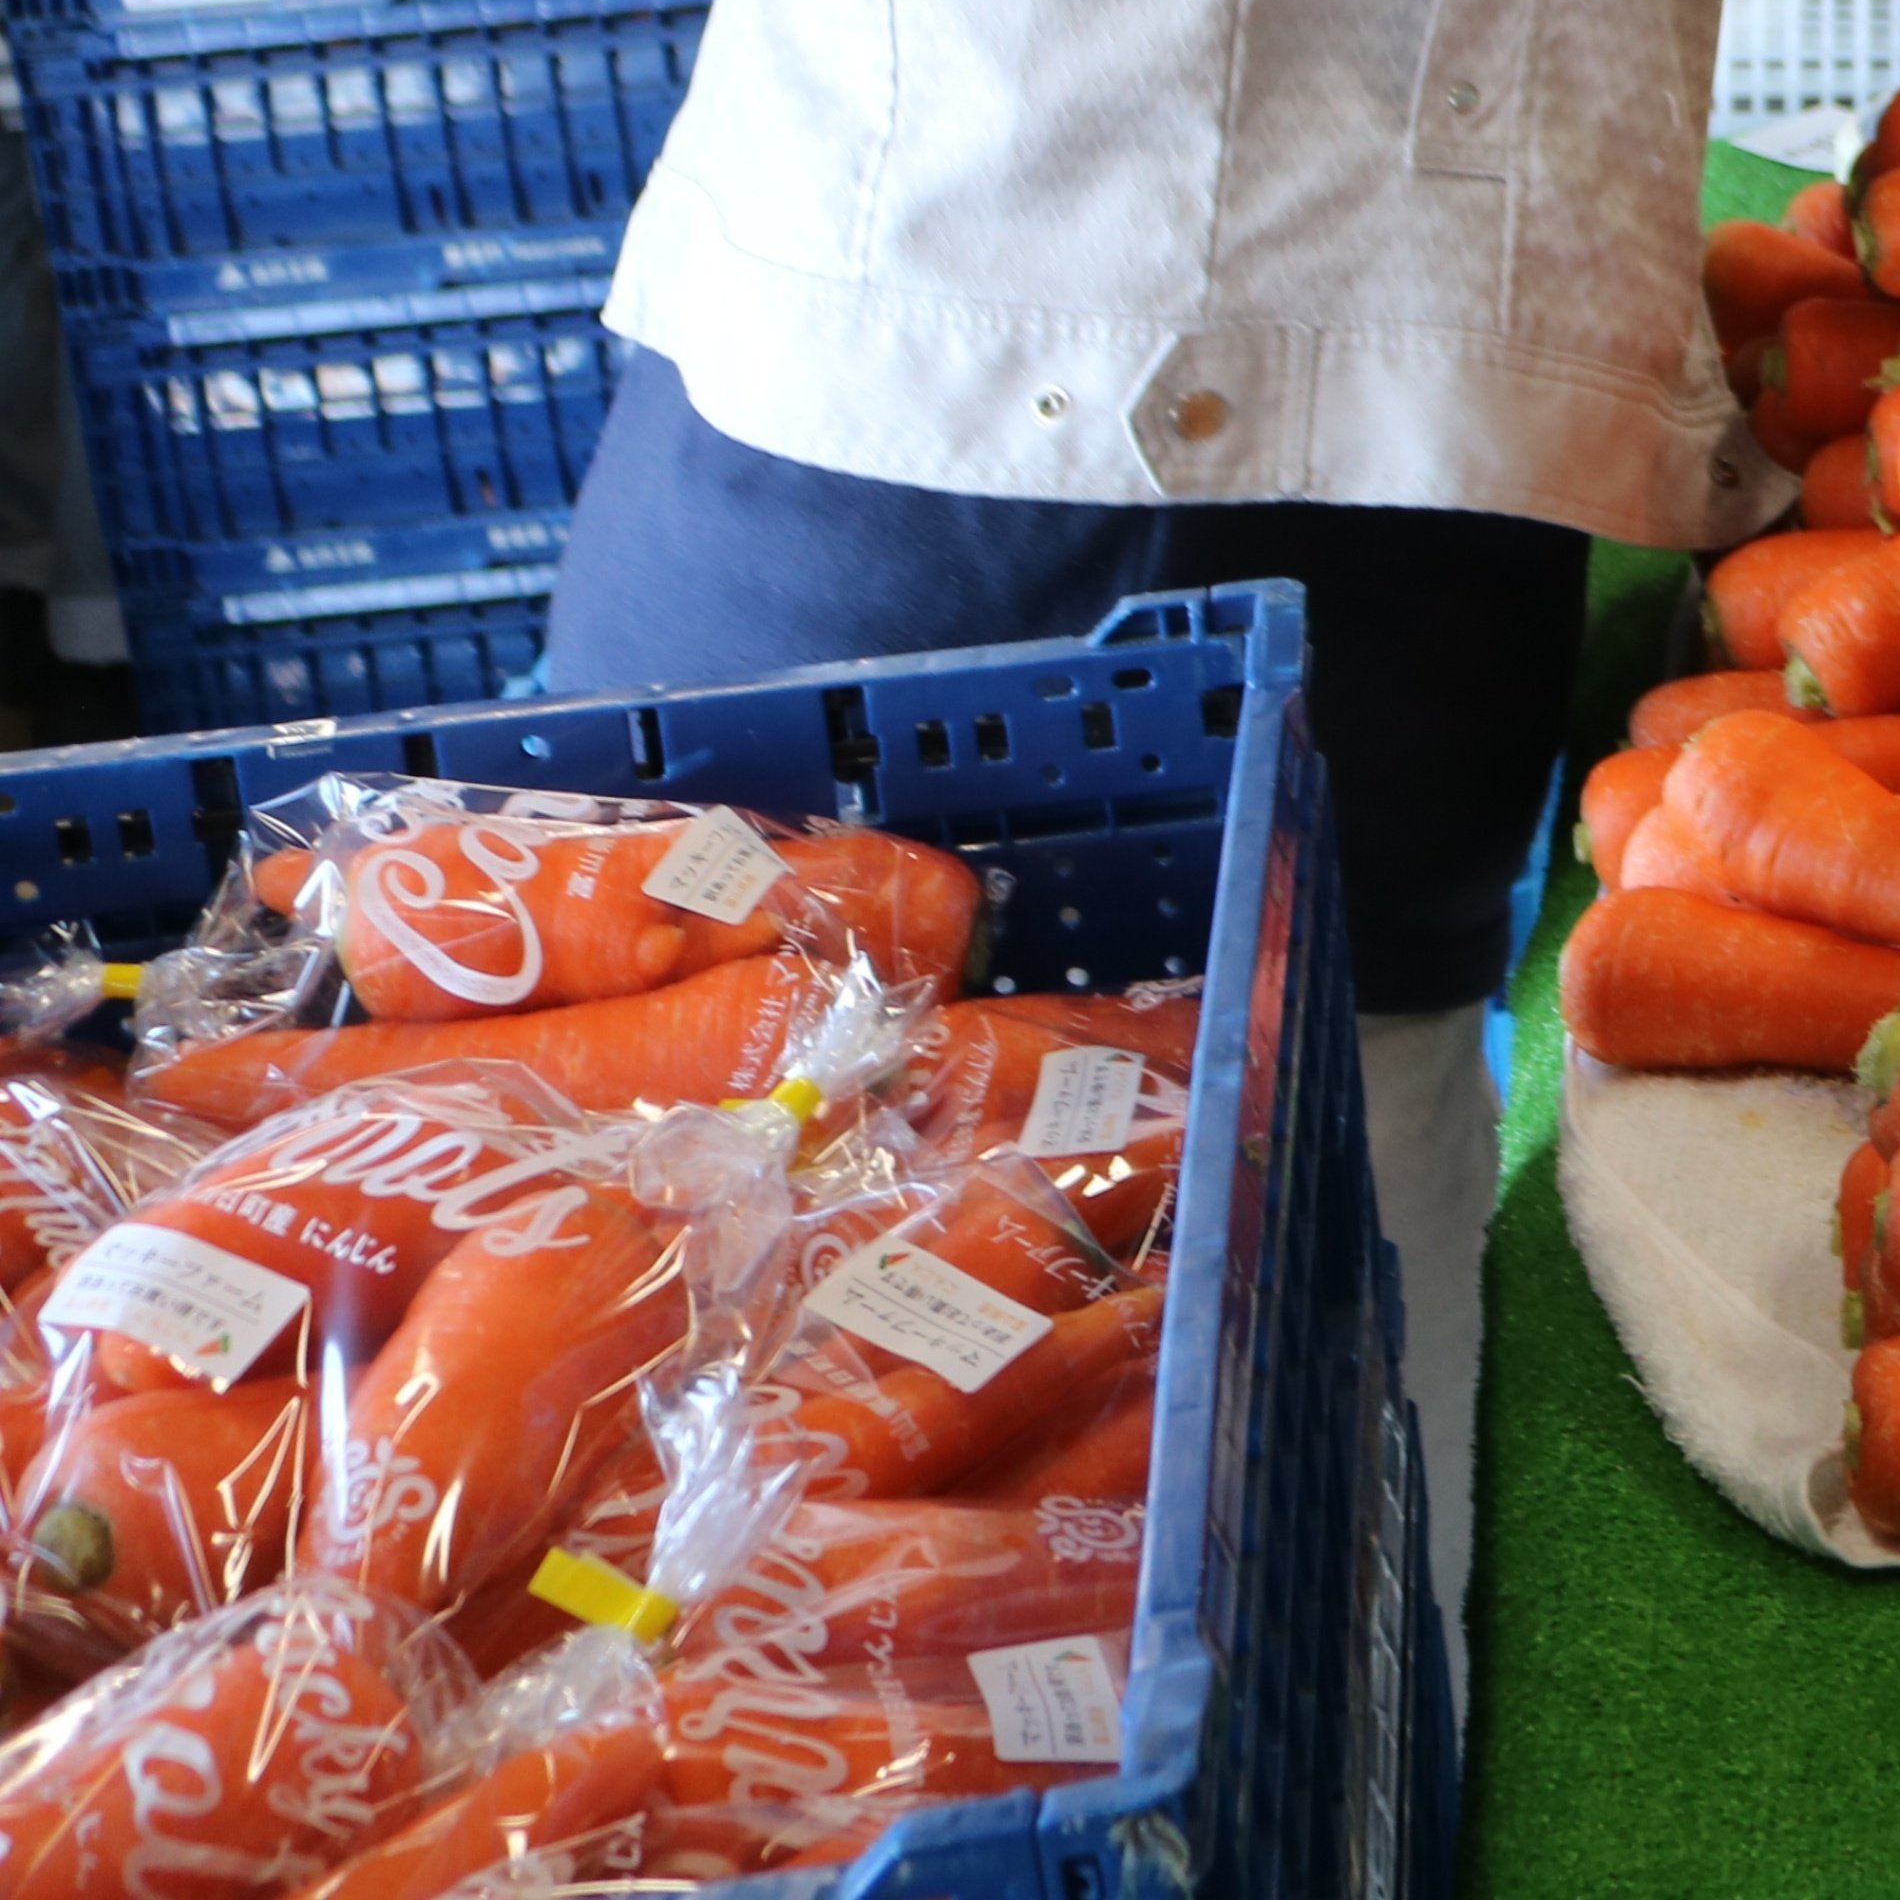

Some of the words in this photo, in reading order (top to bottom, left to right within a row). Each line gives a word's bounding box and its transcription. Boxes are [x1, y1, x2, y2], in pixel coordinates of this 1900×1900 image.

[105, 1239, 262, 1313] マッキーファーム
[298, 1214, 397, 1279] にんじん
[843, 1285, 979, 1370] マッキーファーム
